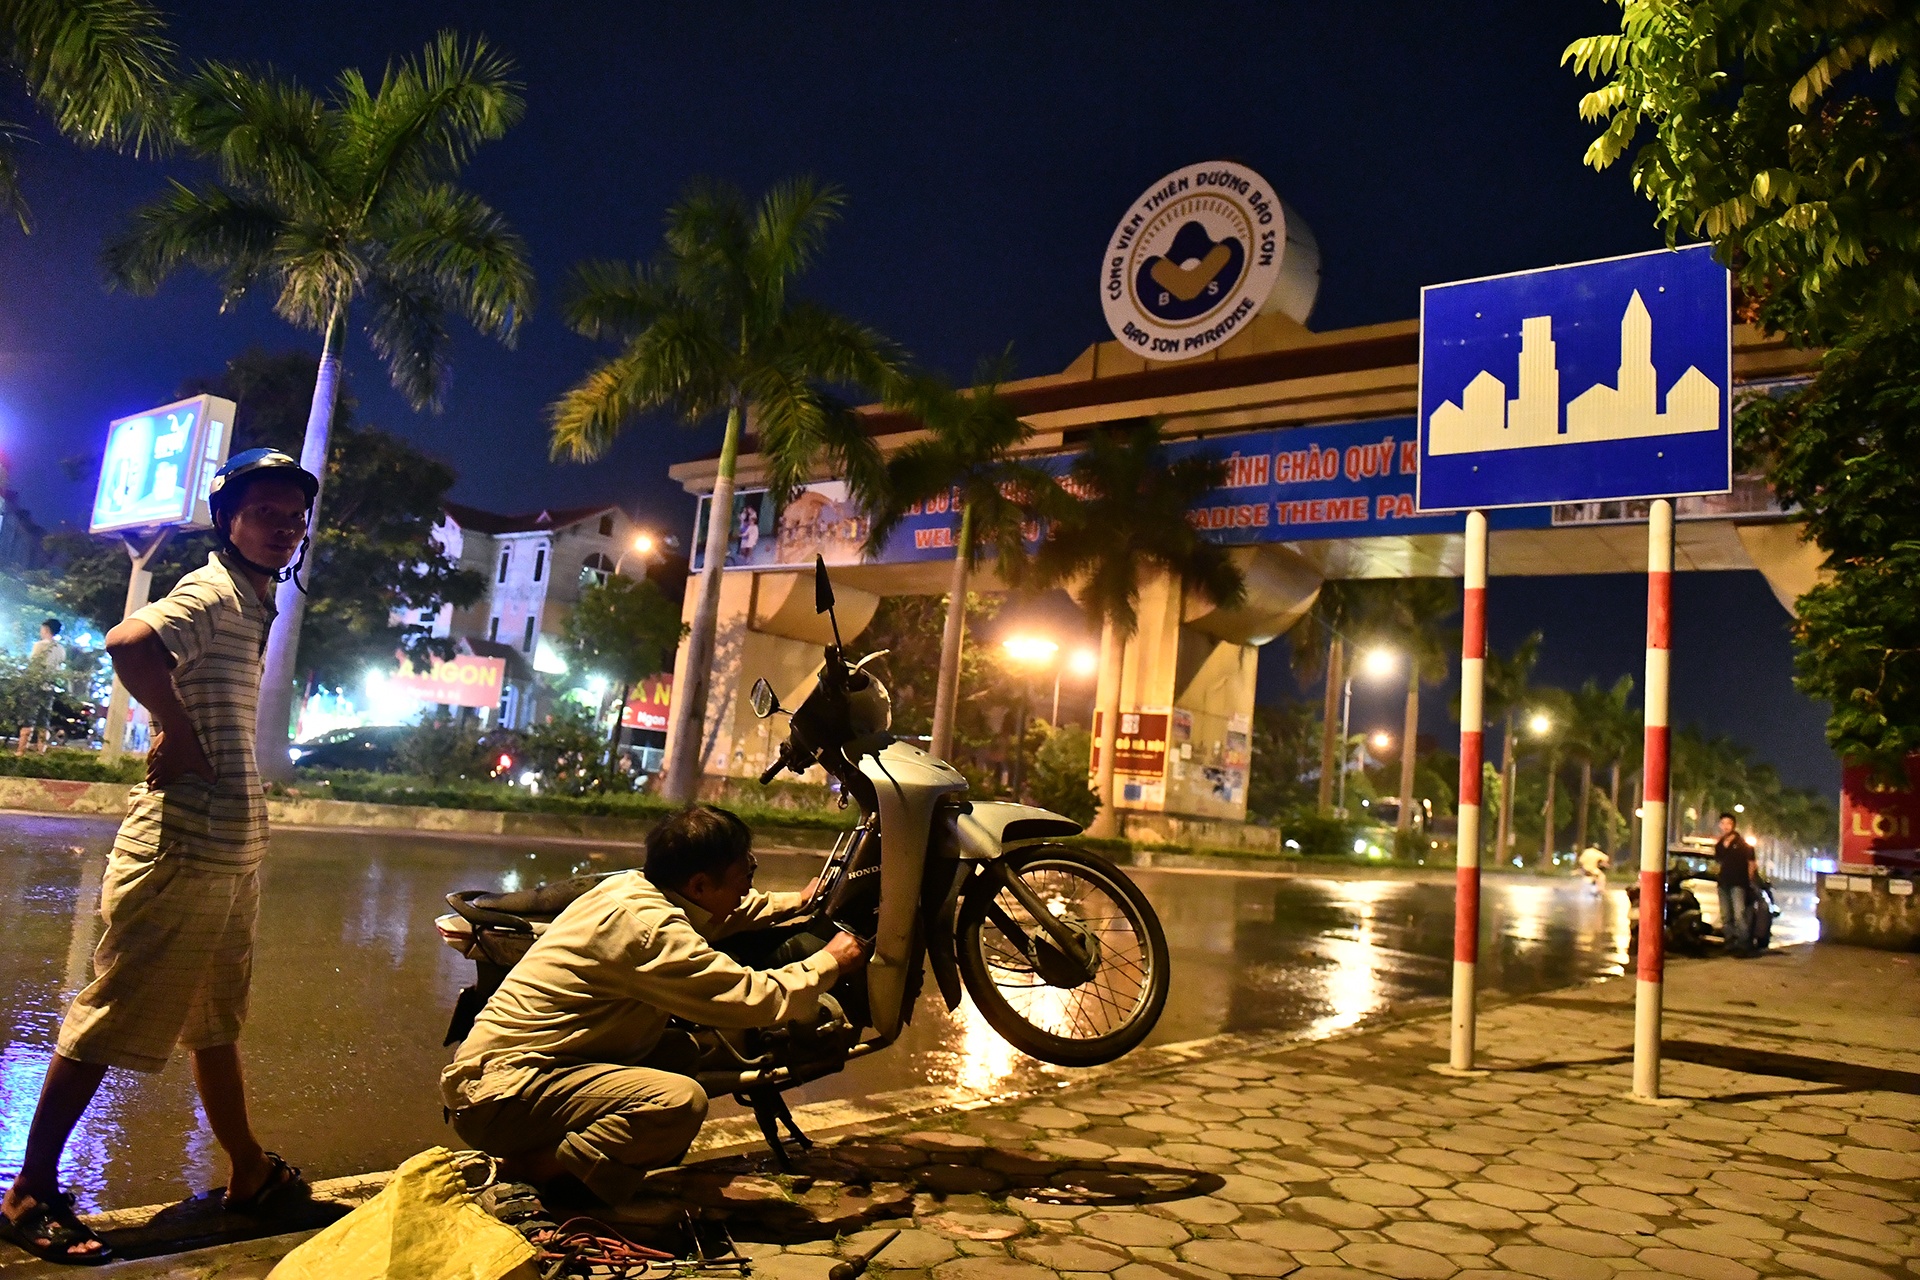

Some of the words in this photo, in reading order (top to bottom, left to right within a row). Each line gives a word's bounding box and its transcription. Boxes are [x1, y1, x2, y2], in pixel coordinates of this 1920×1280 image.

[1107, 256, 1124, 300] CÔNG
[1143, 176, 1190, 212] THIÊN
[1122, 321, 1150, 346] BAO
[1184, 296, 1256, 351] PARADISE
[1275, 443, 1340, 484] CHÀO
[1345, 436, 1396, 482] QUÝ
[1277, 496, 1370, 525] THEME
